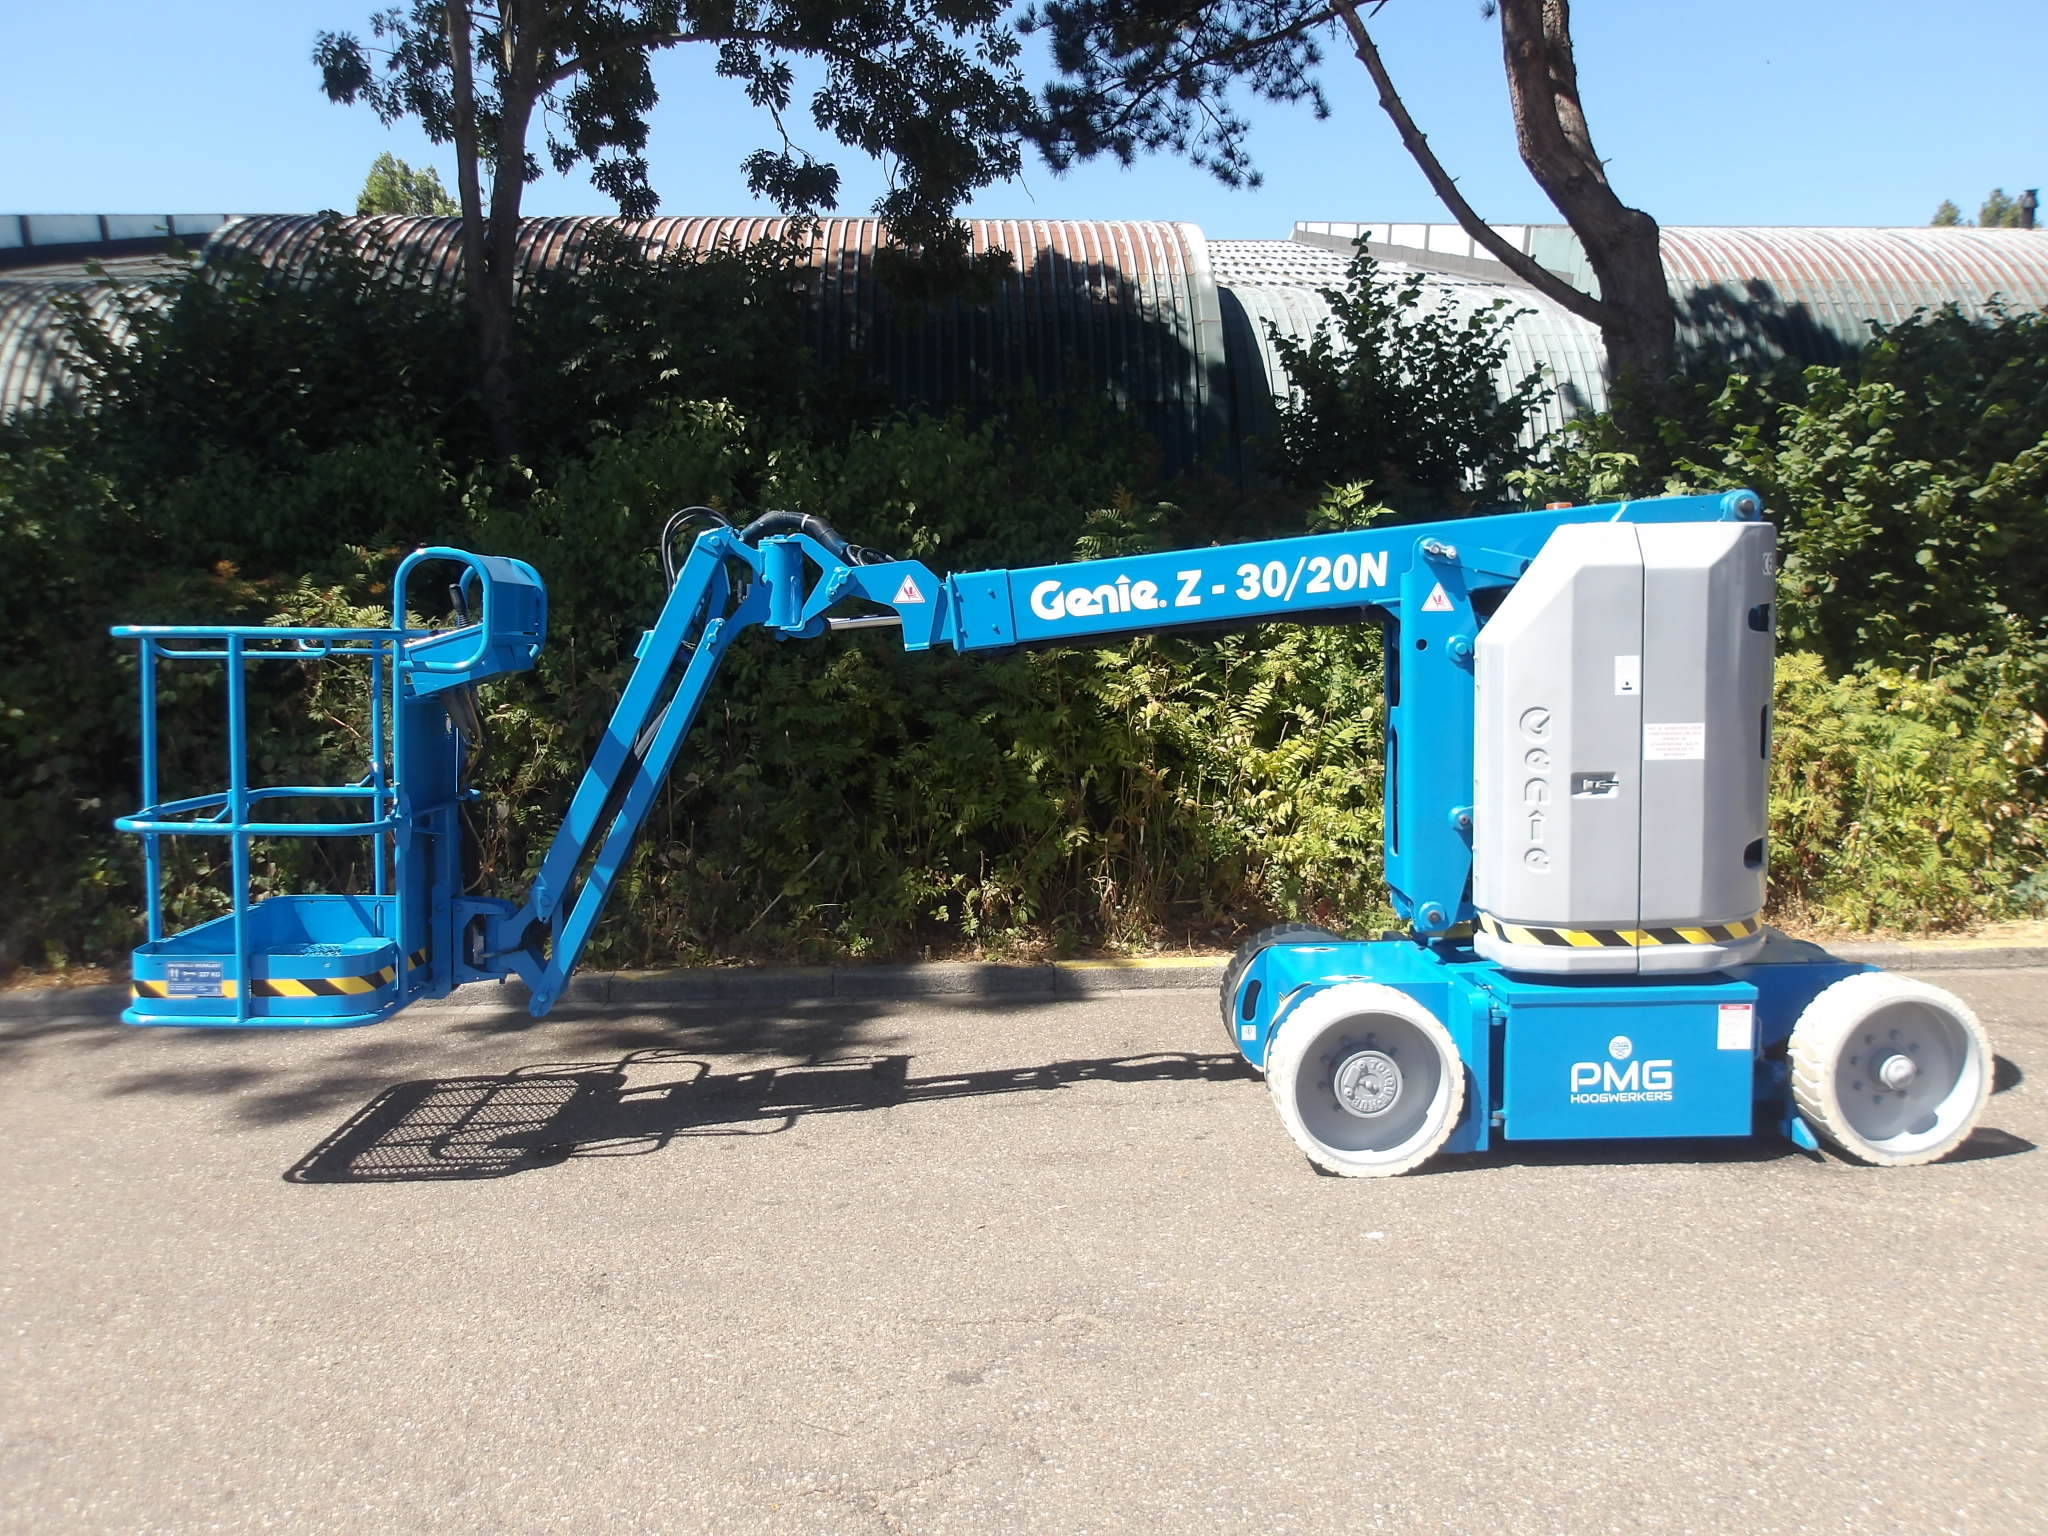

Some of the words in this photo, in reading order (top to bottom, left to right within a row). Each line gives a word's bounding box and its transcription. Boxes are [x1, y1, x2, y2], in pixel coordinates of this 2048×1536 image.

[1030, 574, 1158, 621] Genie
[1175, 569, 1202, 607] Z
[1235, 551, 1388, 601] 30/20N
[1571, 1059, 1673, 1092] PMG
[1570, 1091, 1673, 1104] HOOGWERKERS
